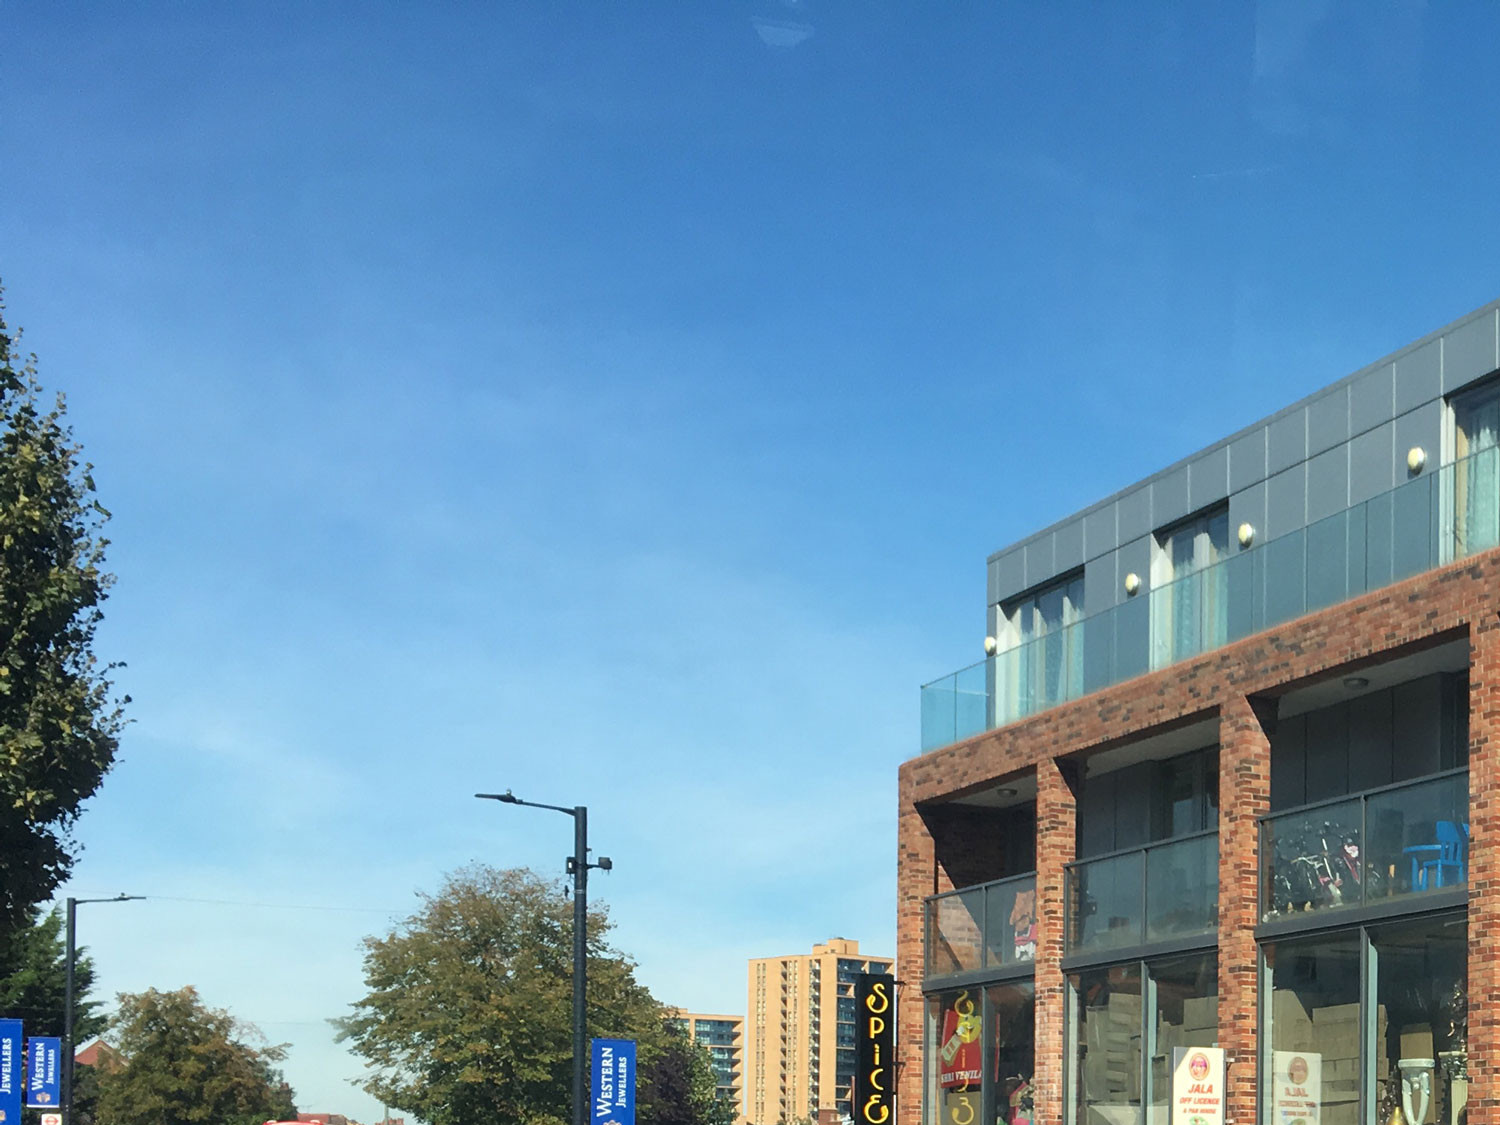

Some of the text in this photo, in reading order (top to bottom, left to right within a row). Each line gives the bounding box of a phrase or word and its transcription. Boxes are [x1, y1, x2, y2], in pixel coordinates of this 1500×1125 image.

[0, 1037, 12, 1095] JEWELLERS
[31, 1042, 45, 1091] WESTERN
[45, 1048, 55, 1085] JEWELLERS
[596, 1046, 614, 1118] WESTERN
[615, 1056, 627, 1108] JEWELLERS
[1188, 1084, 1214, 1094] JALA
